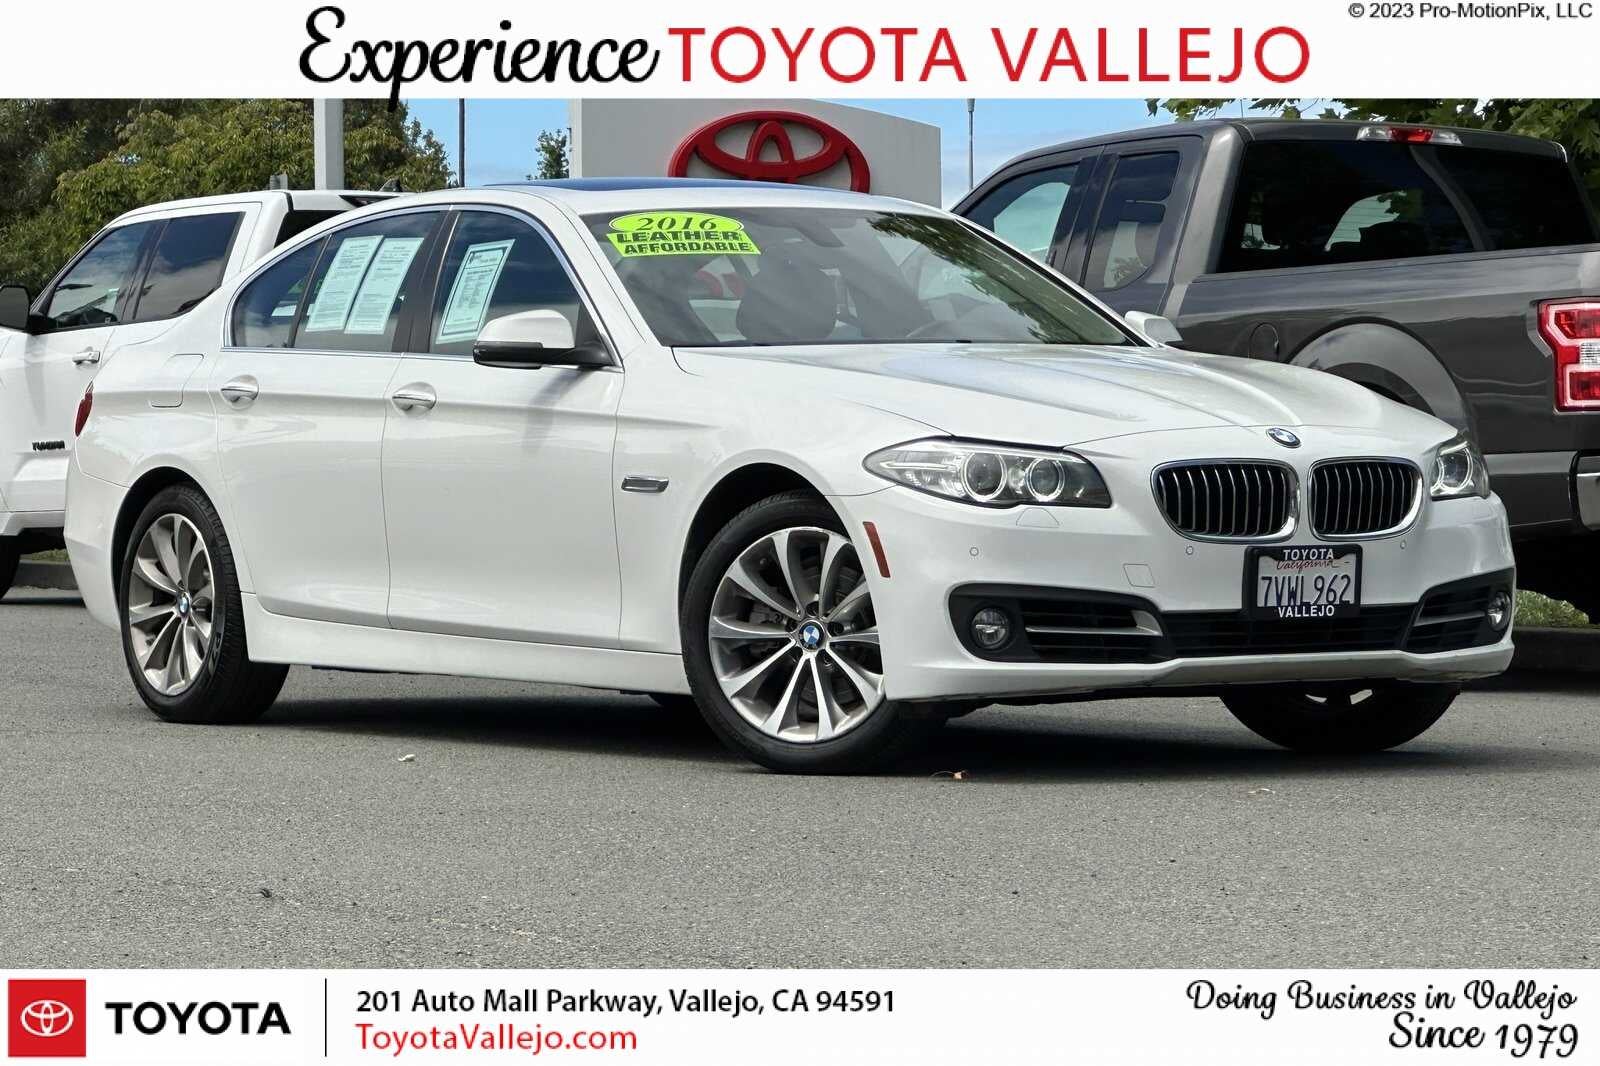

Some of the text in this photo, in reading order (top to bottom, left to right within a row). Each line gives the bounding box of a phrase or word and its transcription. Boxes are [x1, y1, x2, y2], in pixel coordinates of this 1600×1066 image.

[637, 216, 717, 231] 2016
[616, 230, 739, 243] LEATHER
[624, 242, 751, 254] AFFORDABLE
[1283, 548, 1334, 560] TOYOTA
[1260, 574, 1351, 607] 7VWL962
[1278, 605, 1335, 618] VALLEJO
